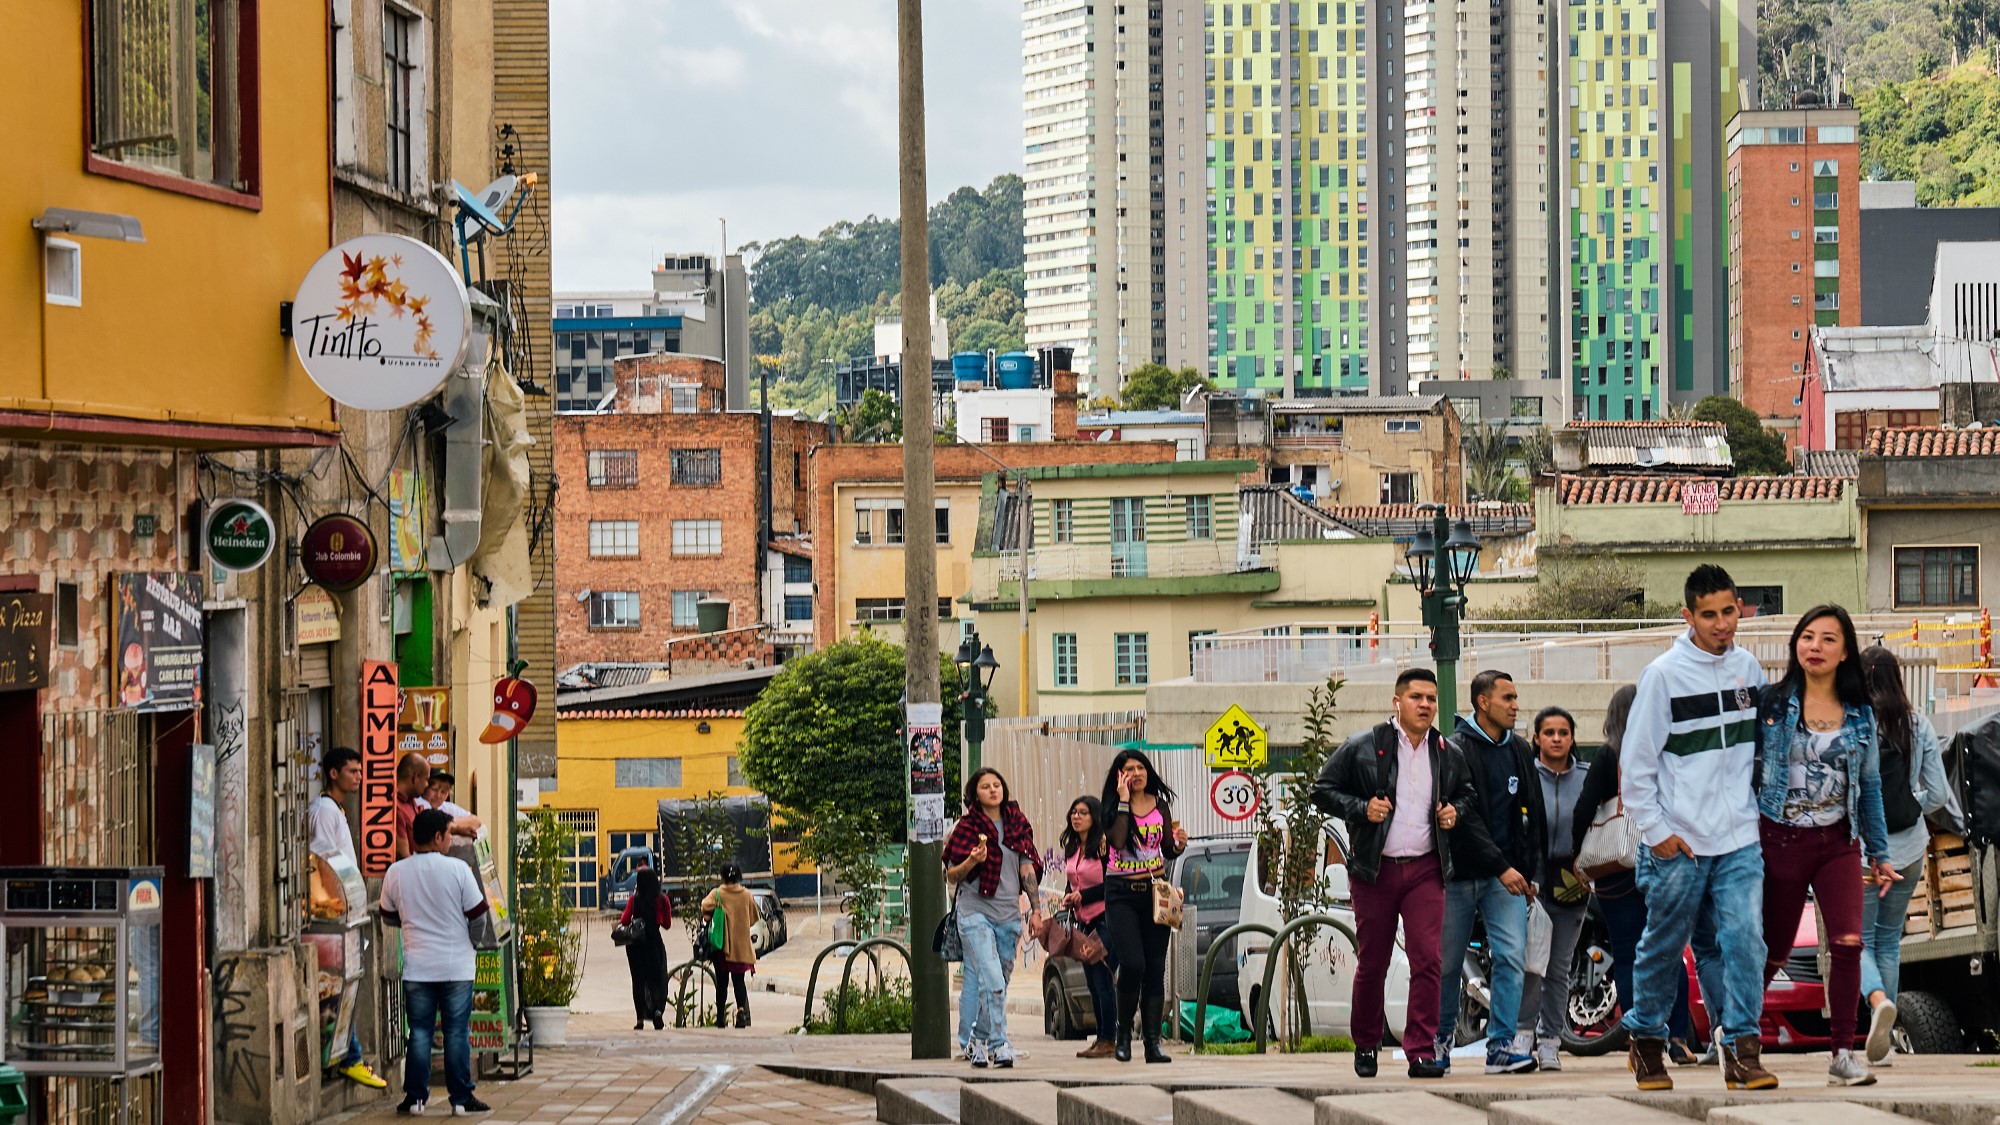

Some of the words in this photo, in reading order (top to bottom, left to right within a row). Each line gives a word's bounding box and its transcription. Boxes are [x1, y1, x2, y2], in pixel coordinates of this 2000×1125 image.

[301, 315, 381, 361] Tintto
[1692, 484, 1716, 493] VENDE
[1682, 495, 1699, 504] ESTA
[214, 536, 265, 548] Heineken
[330, 552, 361, 561] Colombia
[11, 599, 43, 635] Pizza
[163, 612, 181, 641] BAR
[159, 669, 175, 682] CARNE
[176, 669, 182, 681] DE
[366, 665, 396, 874] ALMUERZOS
[1223, 786, 1249, 804] 30
